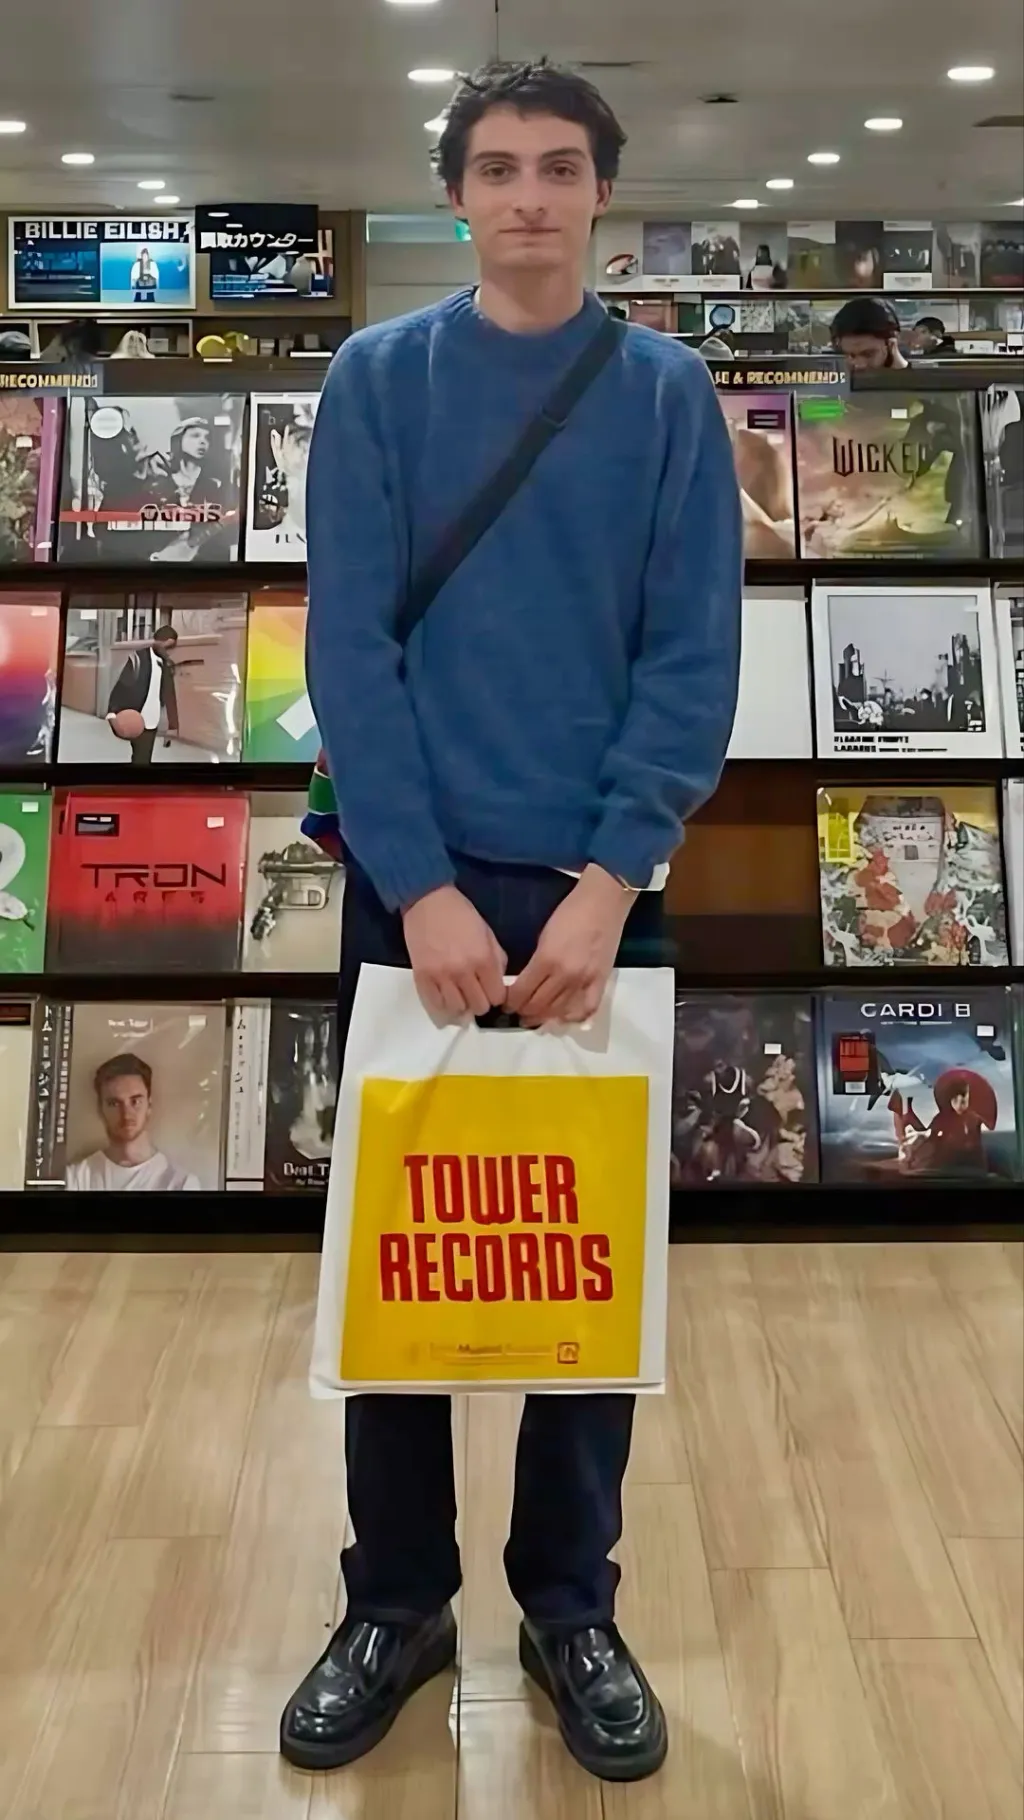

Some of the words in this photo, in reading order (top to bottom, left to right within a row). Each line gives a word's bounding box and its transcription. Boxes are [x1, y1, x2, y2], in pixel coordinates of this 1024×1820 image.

[25, 222, 98, 239] BILLIE
[80, 863, 227, 889] TRON
[860, 1003, 943, 1018] CARDI
[954, 1003, 972, 1018] B
[403, 1154, 580, 1225] TOWER
[379, 1232, 614, 1303] RECORDS
